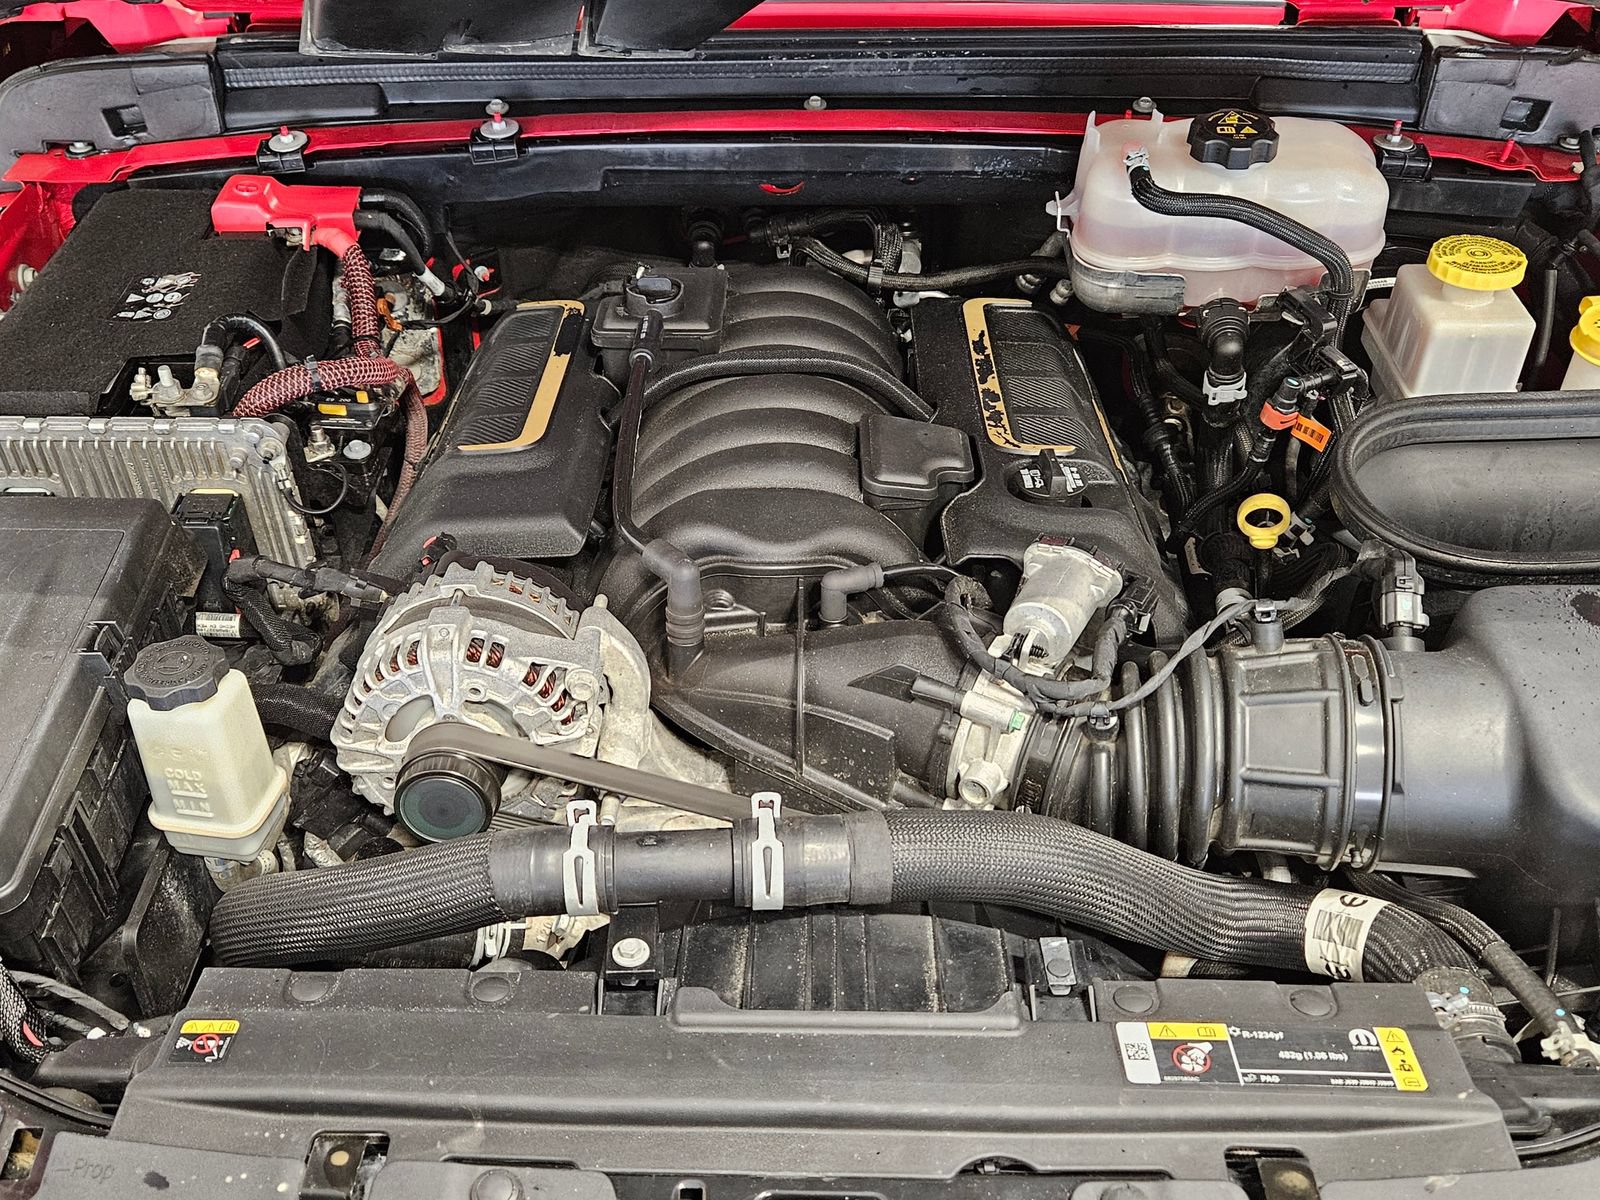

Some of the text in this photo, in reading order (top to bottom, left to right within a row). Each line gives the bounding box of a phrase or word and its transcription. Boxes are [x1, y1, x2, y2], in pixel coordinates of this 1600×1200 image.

[164, 767, 202, 781] COLD
[167, 779, 207, 794] MAX
[172, 798, 211, 812] MIN
[70, 1158, 115, 1185] Prop
